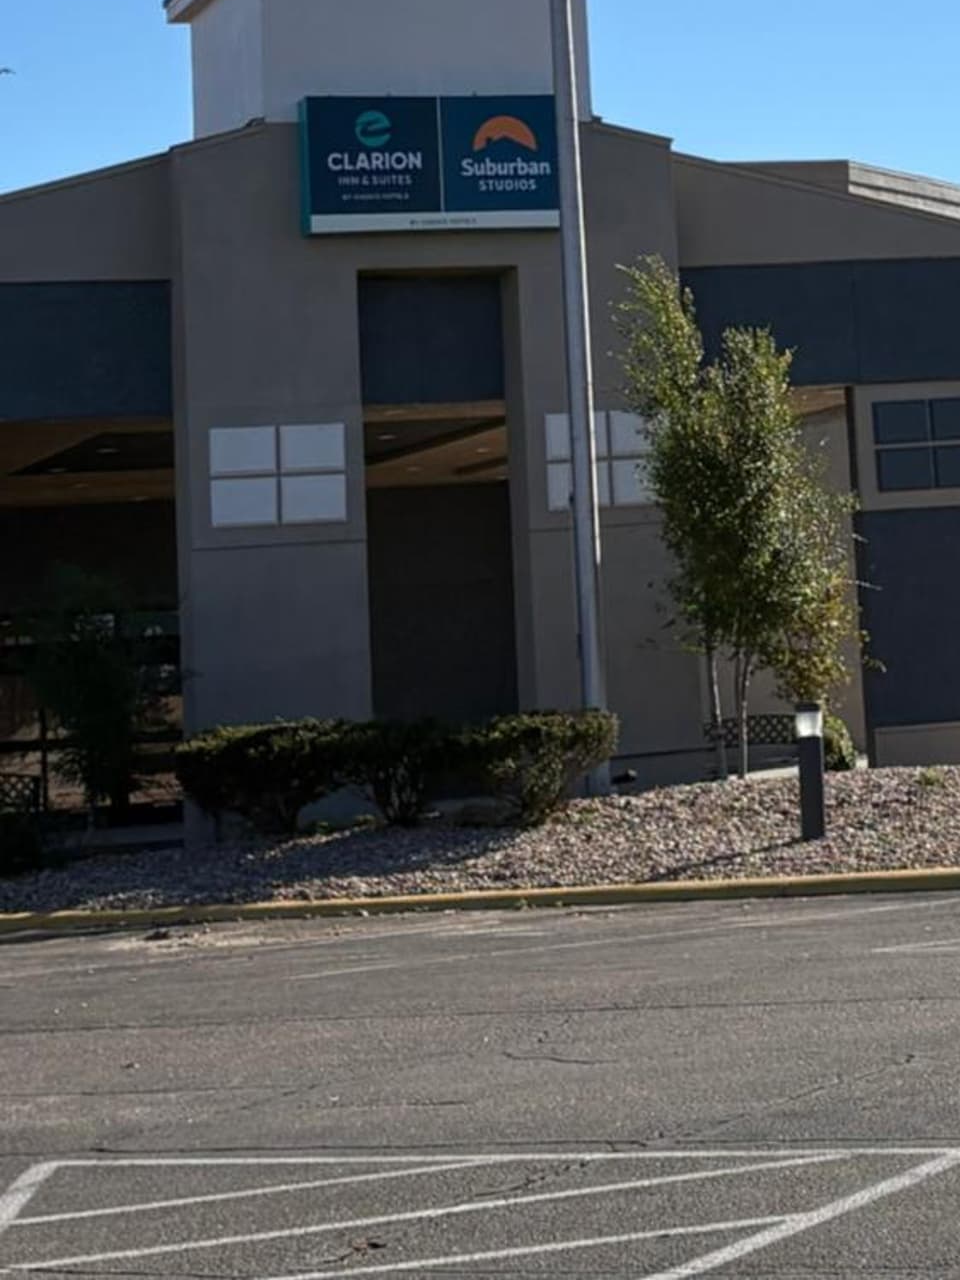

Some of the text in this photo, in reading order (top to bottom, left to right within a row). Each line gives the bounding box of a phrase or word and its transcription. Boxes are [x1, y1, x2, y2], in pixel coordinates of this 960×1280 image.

[327, 151, 423, 171] CLARION
[460, 157, 551, 176] Suburban
[338, 175, 360, 185] INN
[371, 174, 412, 185] SUITES
[479, 178, 537, 192] STUDIOS
